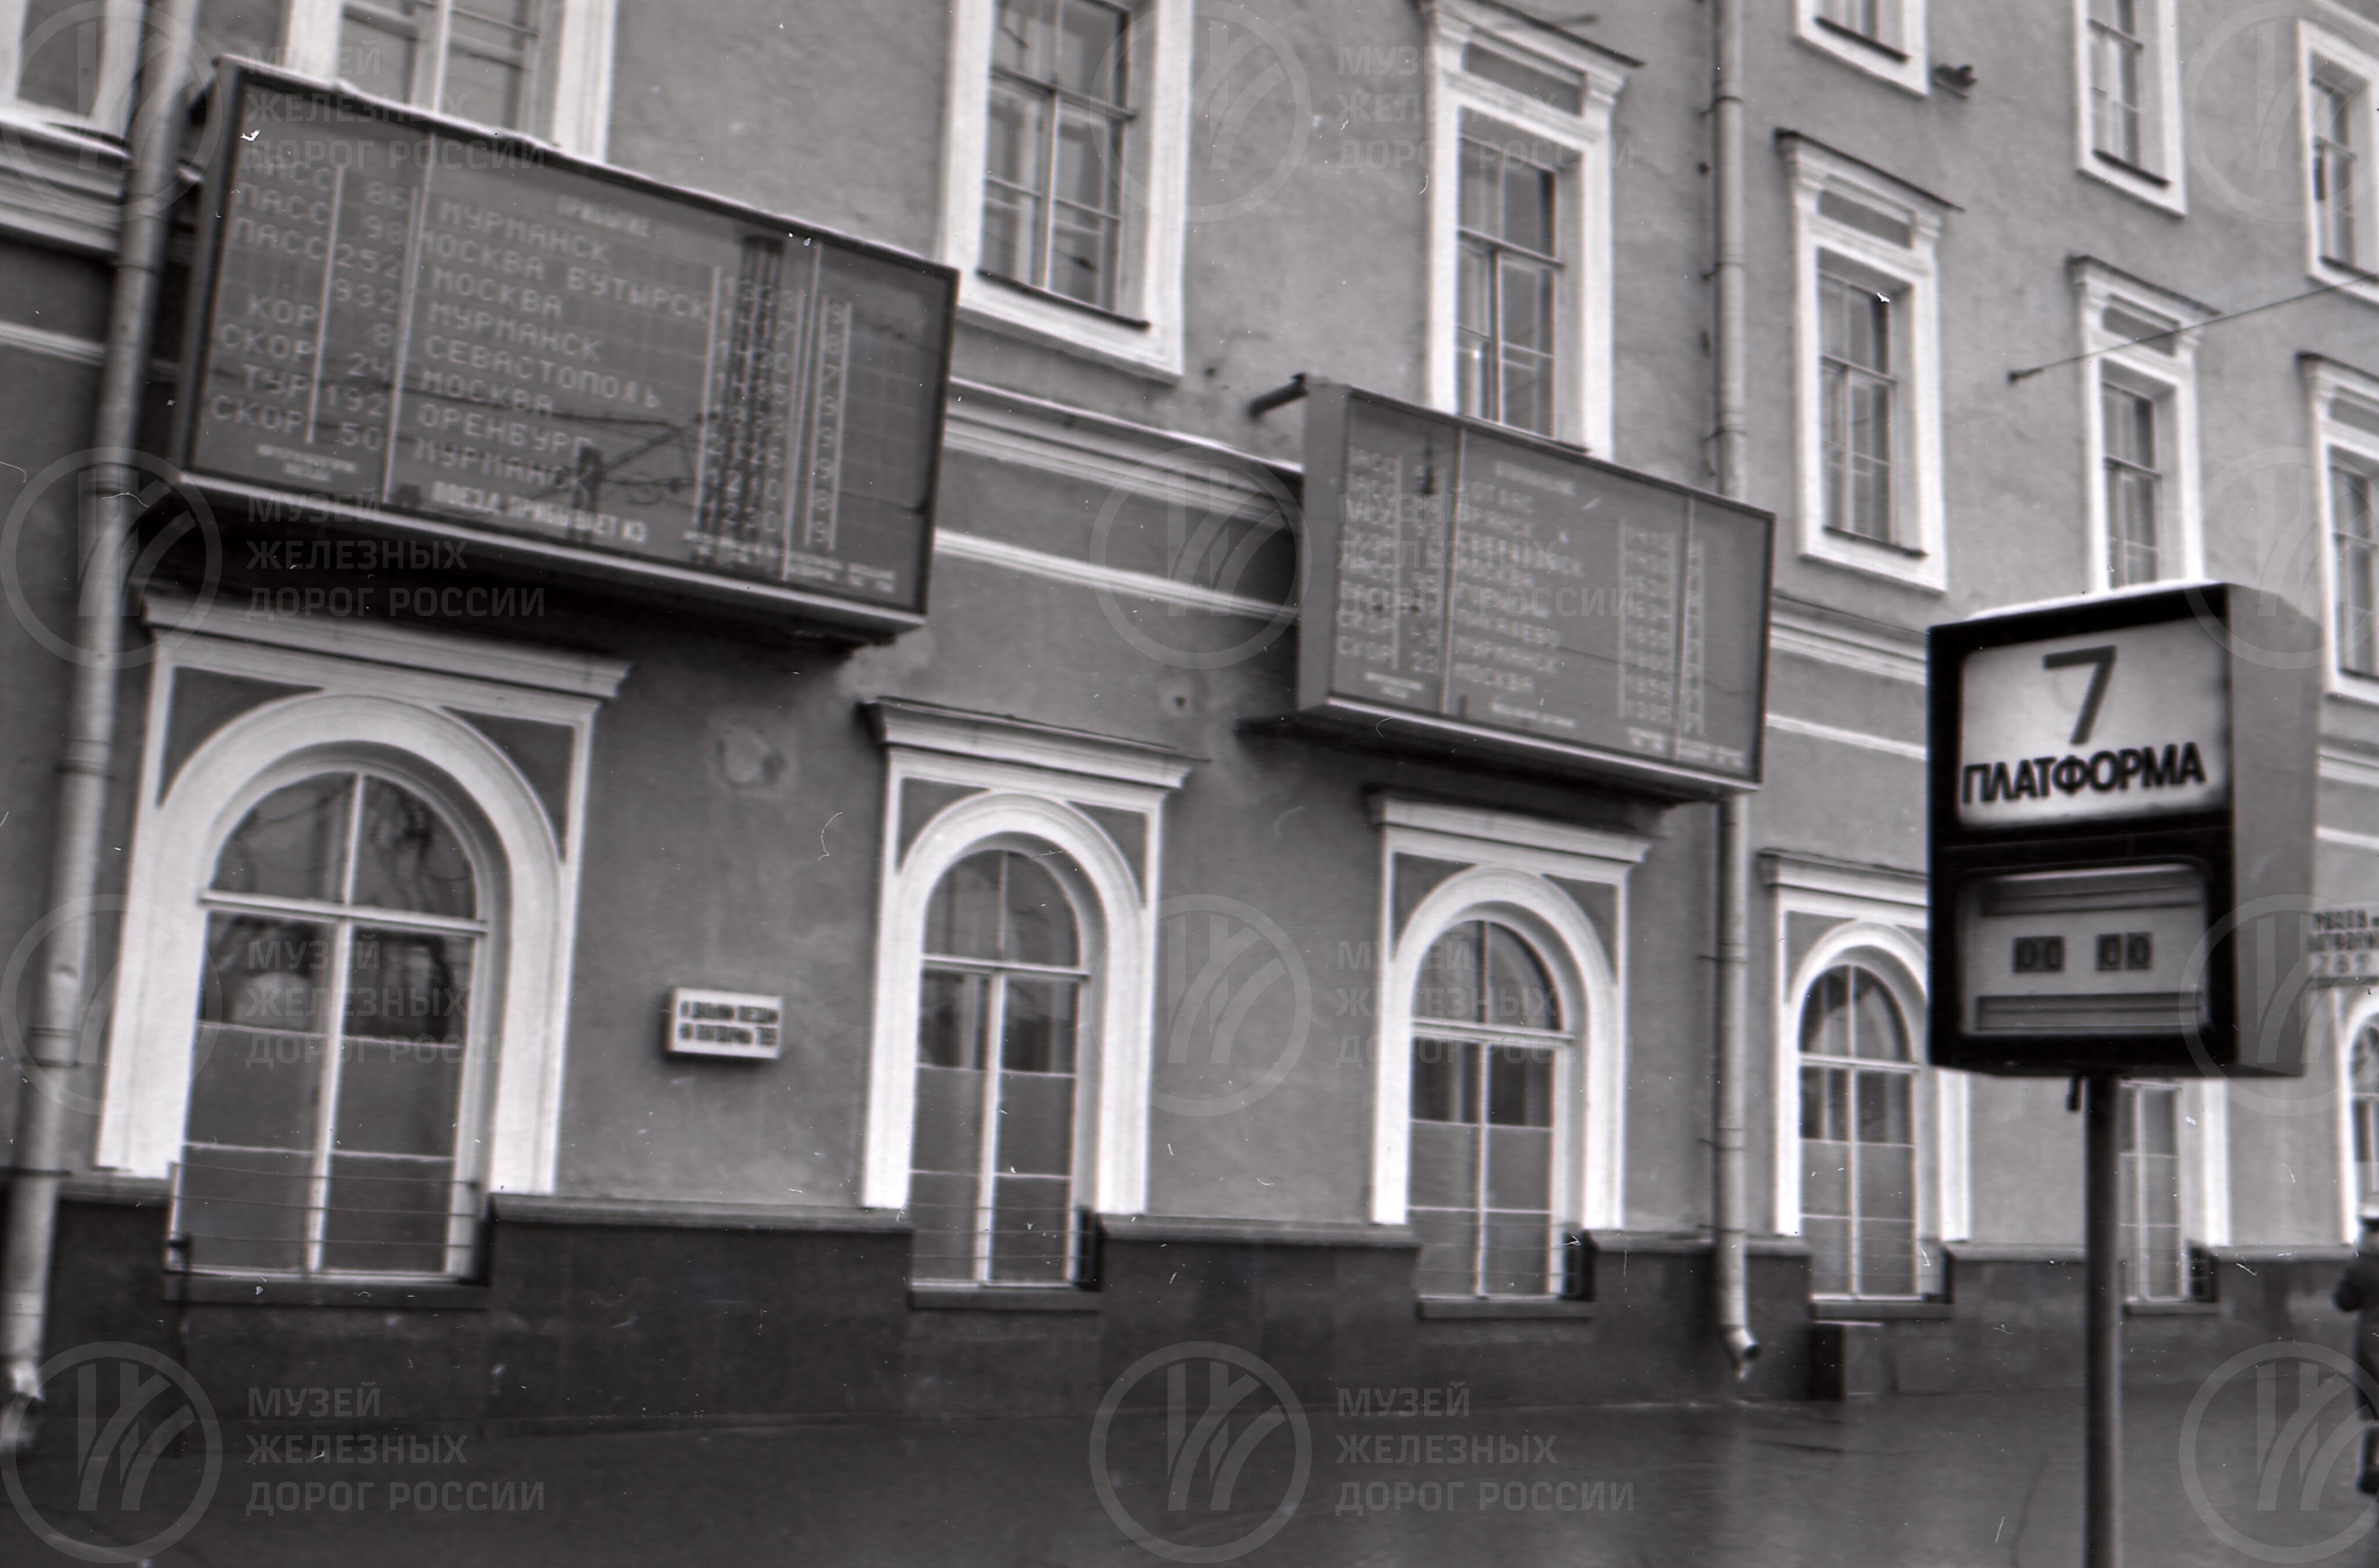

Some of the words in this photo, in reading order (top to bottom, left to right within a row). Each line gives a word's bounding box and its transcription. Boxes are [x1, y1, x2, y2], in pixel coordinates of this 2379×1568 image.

[238, 179, 332, 226] ПАСС
[439, 199, 611, 266] МУРМАНСК
[232, 215, 328, 261] ПАСС
[432, 265, 563, 320] МОСКВА
[218, 321, 314, 365] СКОР
[246, 290, 318, 330] КОР
[424, 333, 662, 410] СЕВАСТОПОЛЬ
[428, 299, 602, 363] МУРМАНСК
[208, 393, 304, 436] СКОР
[338, 420, 384, 453] 50
[2043, 645, 2117, 746] 7
[1961, 742, 2206, 804] ПЛАТФОРМА
